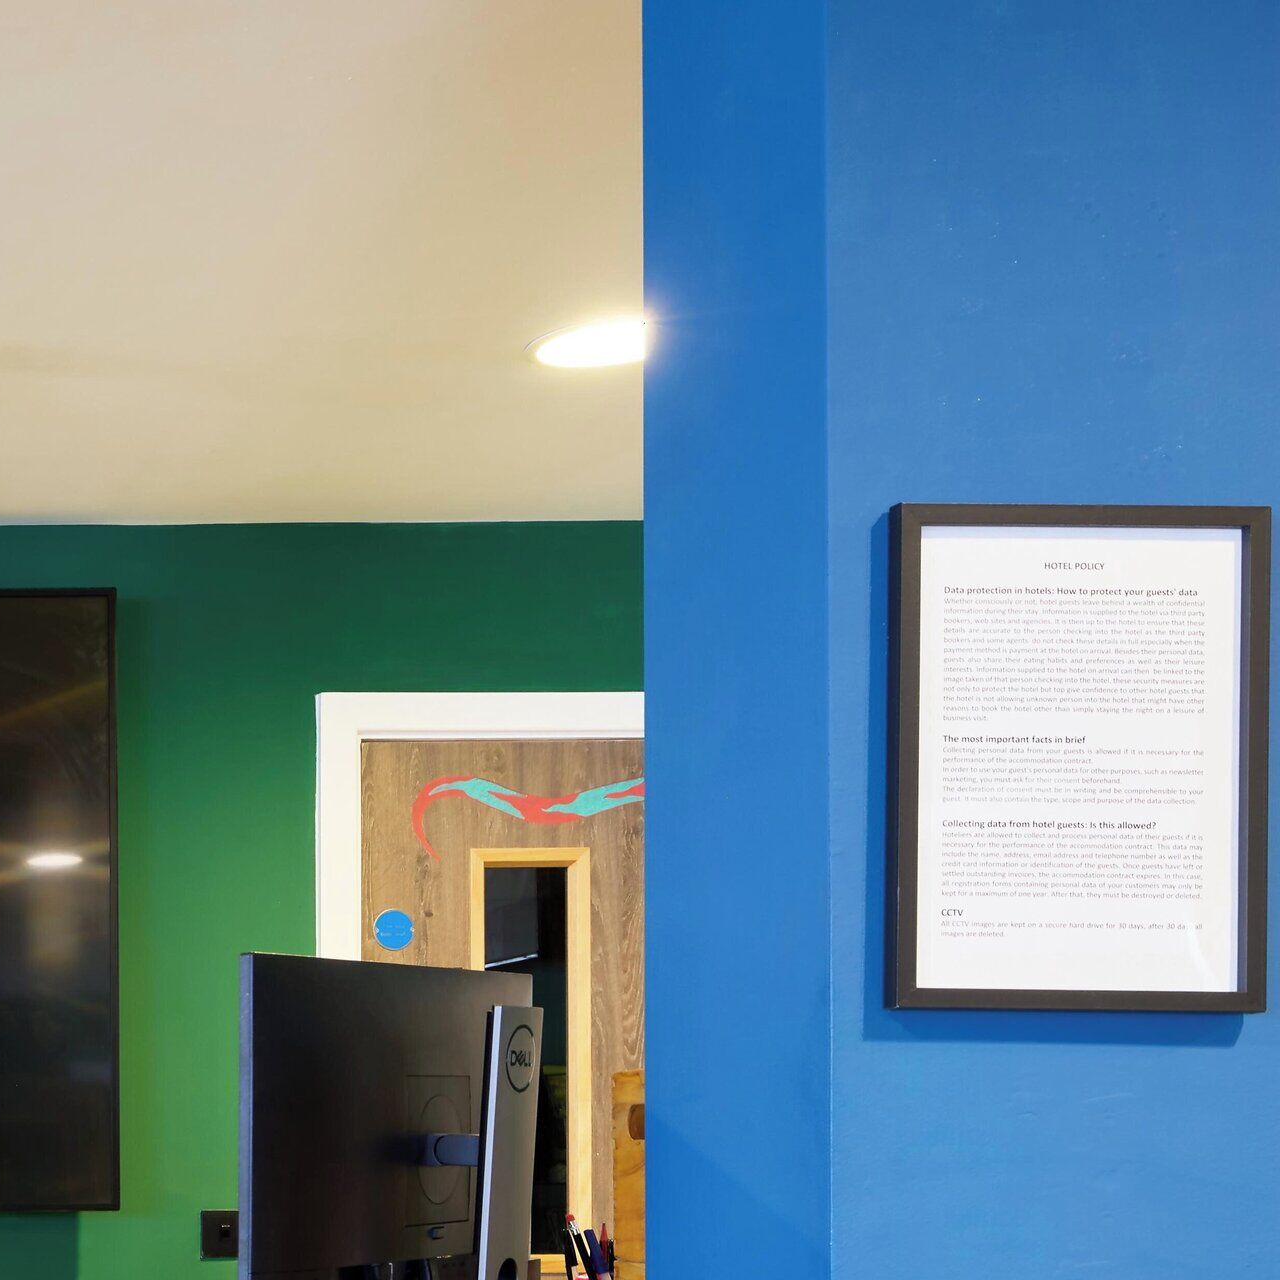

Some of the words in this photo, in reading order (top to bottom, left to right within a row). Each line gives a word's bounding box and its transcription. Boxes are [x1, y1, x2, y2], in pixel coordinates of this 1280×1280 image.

[943, 820, 984, 829] Collecting
[1057, 822, 1087, 830] guests:
[510, 1050, 533, 1067] DELL
